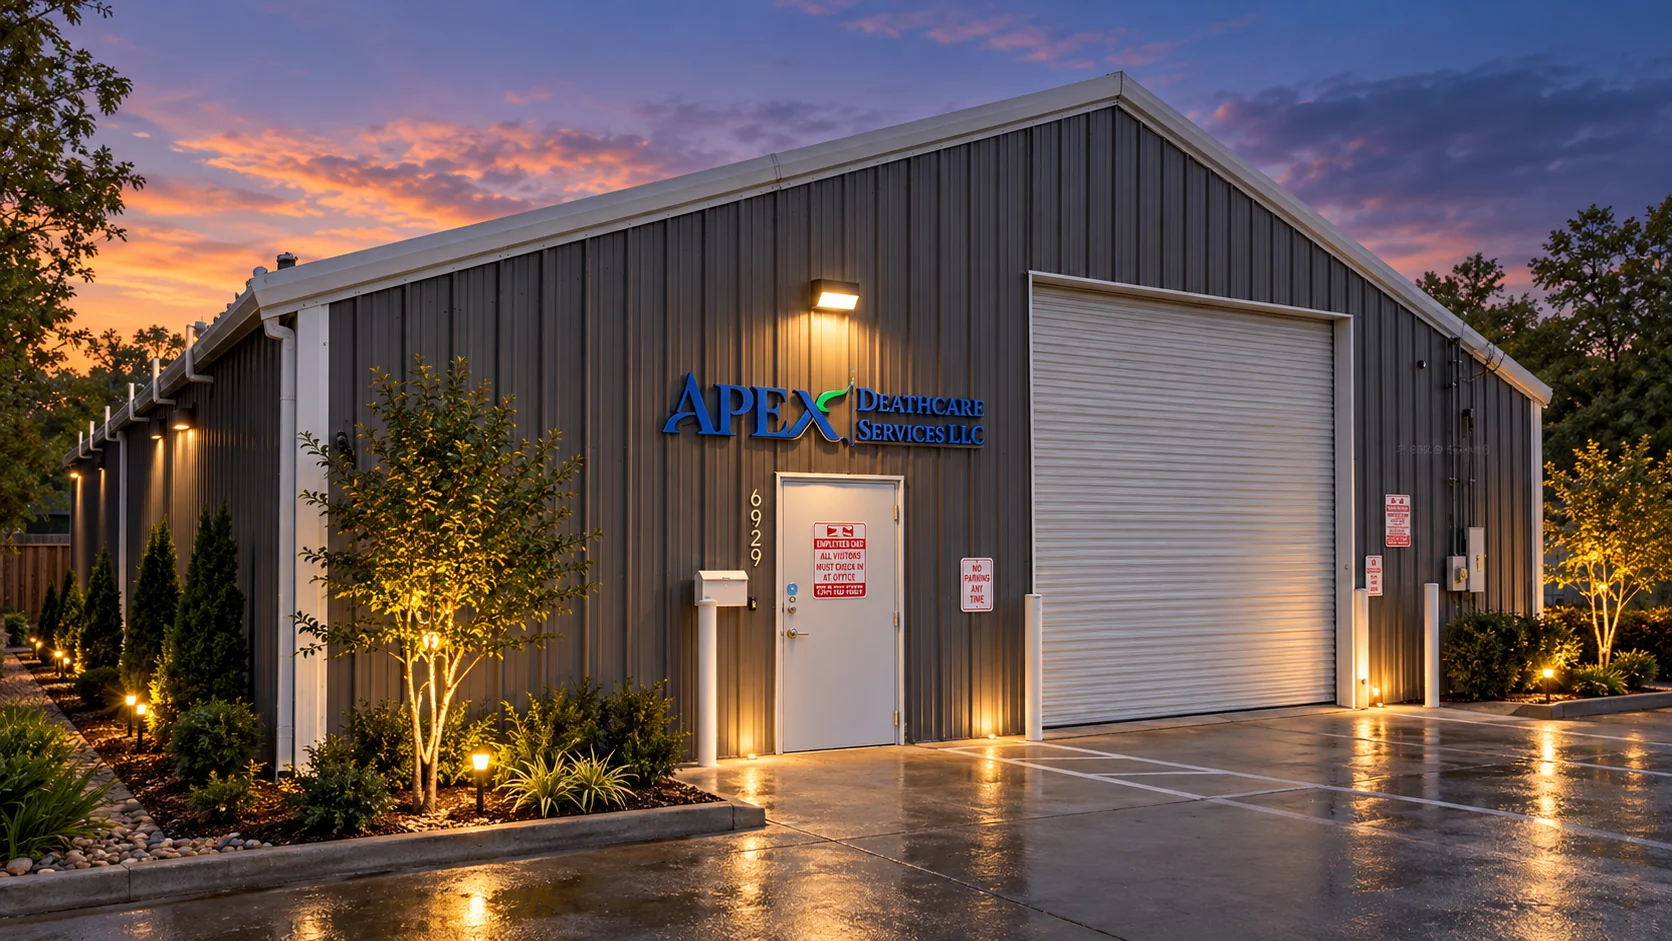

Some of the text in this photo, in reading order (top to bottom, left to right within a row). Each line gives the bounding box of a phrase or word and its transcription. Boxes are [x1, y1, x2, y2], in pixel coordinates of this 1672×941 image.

[661, 371, 846, 443] APEX
[856, 387, 985, 416] DEATHCARE
[856, 418, 985, 445] SERVICES LLC
[750, 488, 762, 567] 6929
[820, 552, 832, 560] ALL
[816, 563, 834, 571] MUST
[823, 573, 832, 581] AT
[970, 595, 985, 604] TIME
